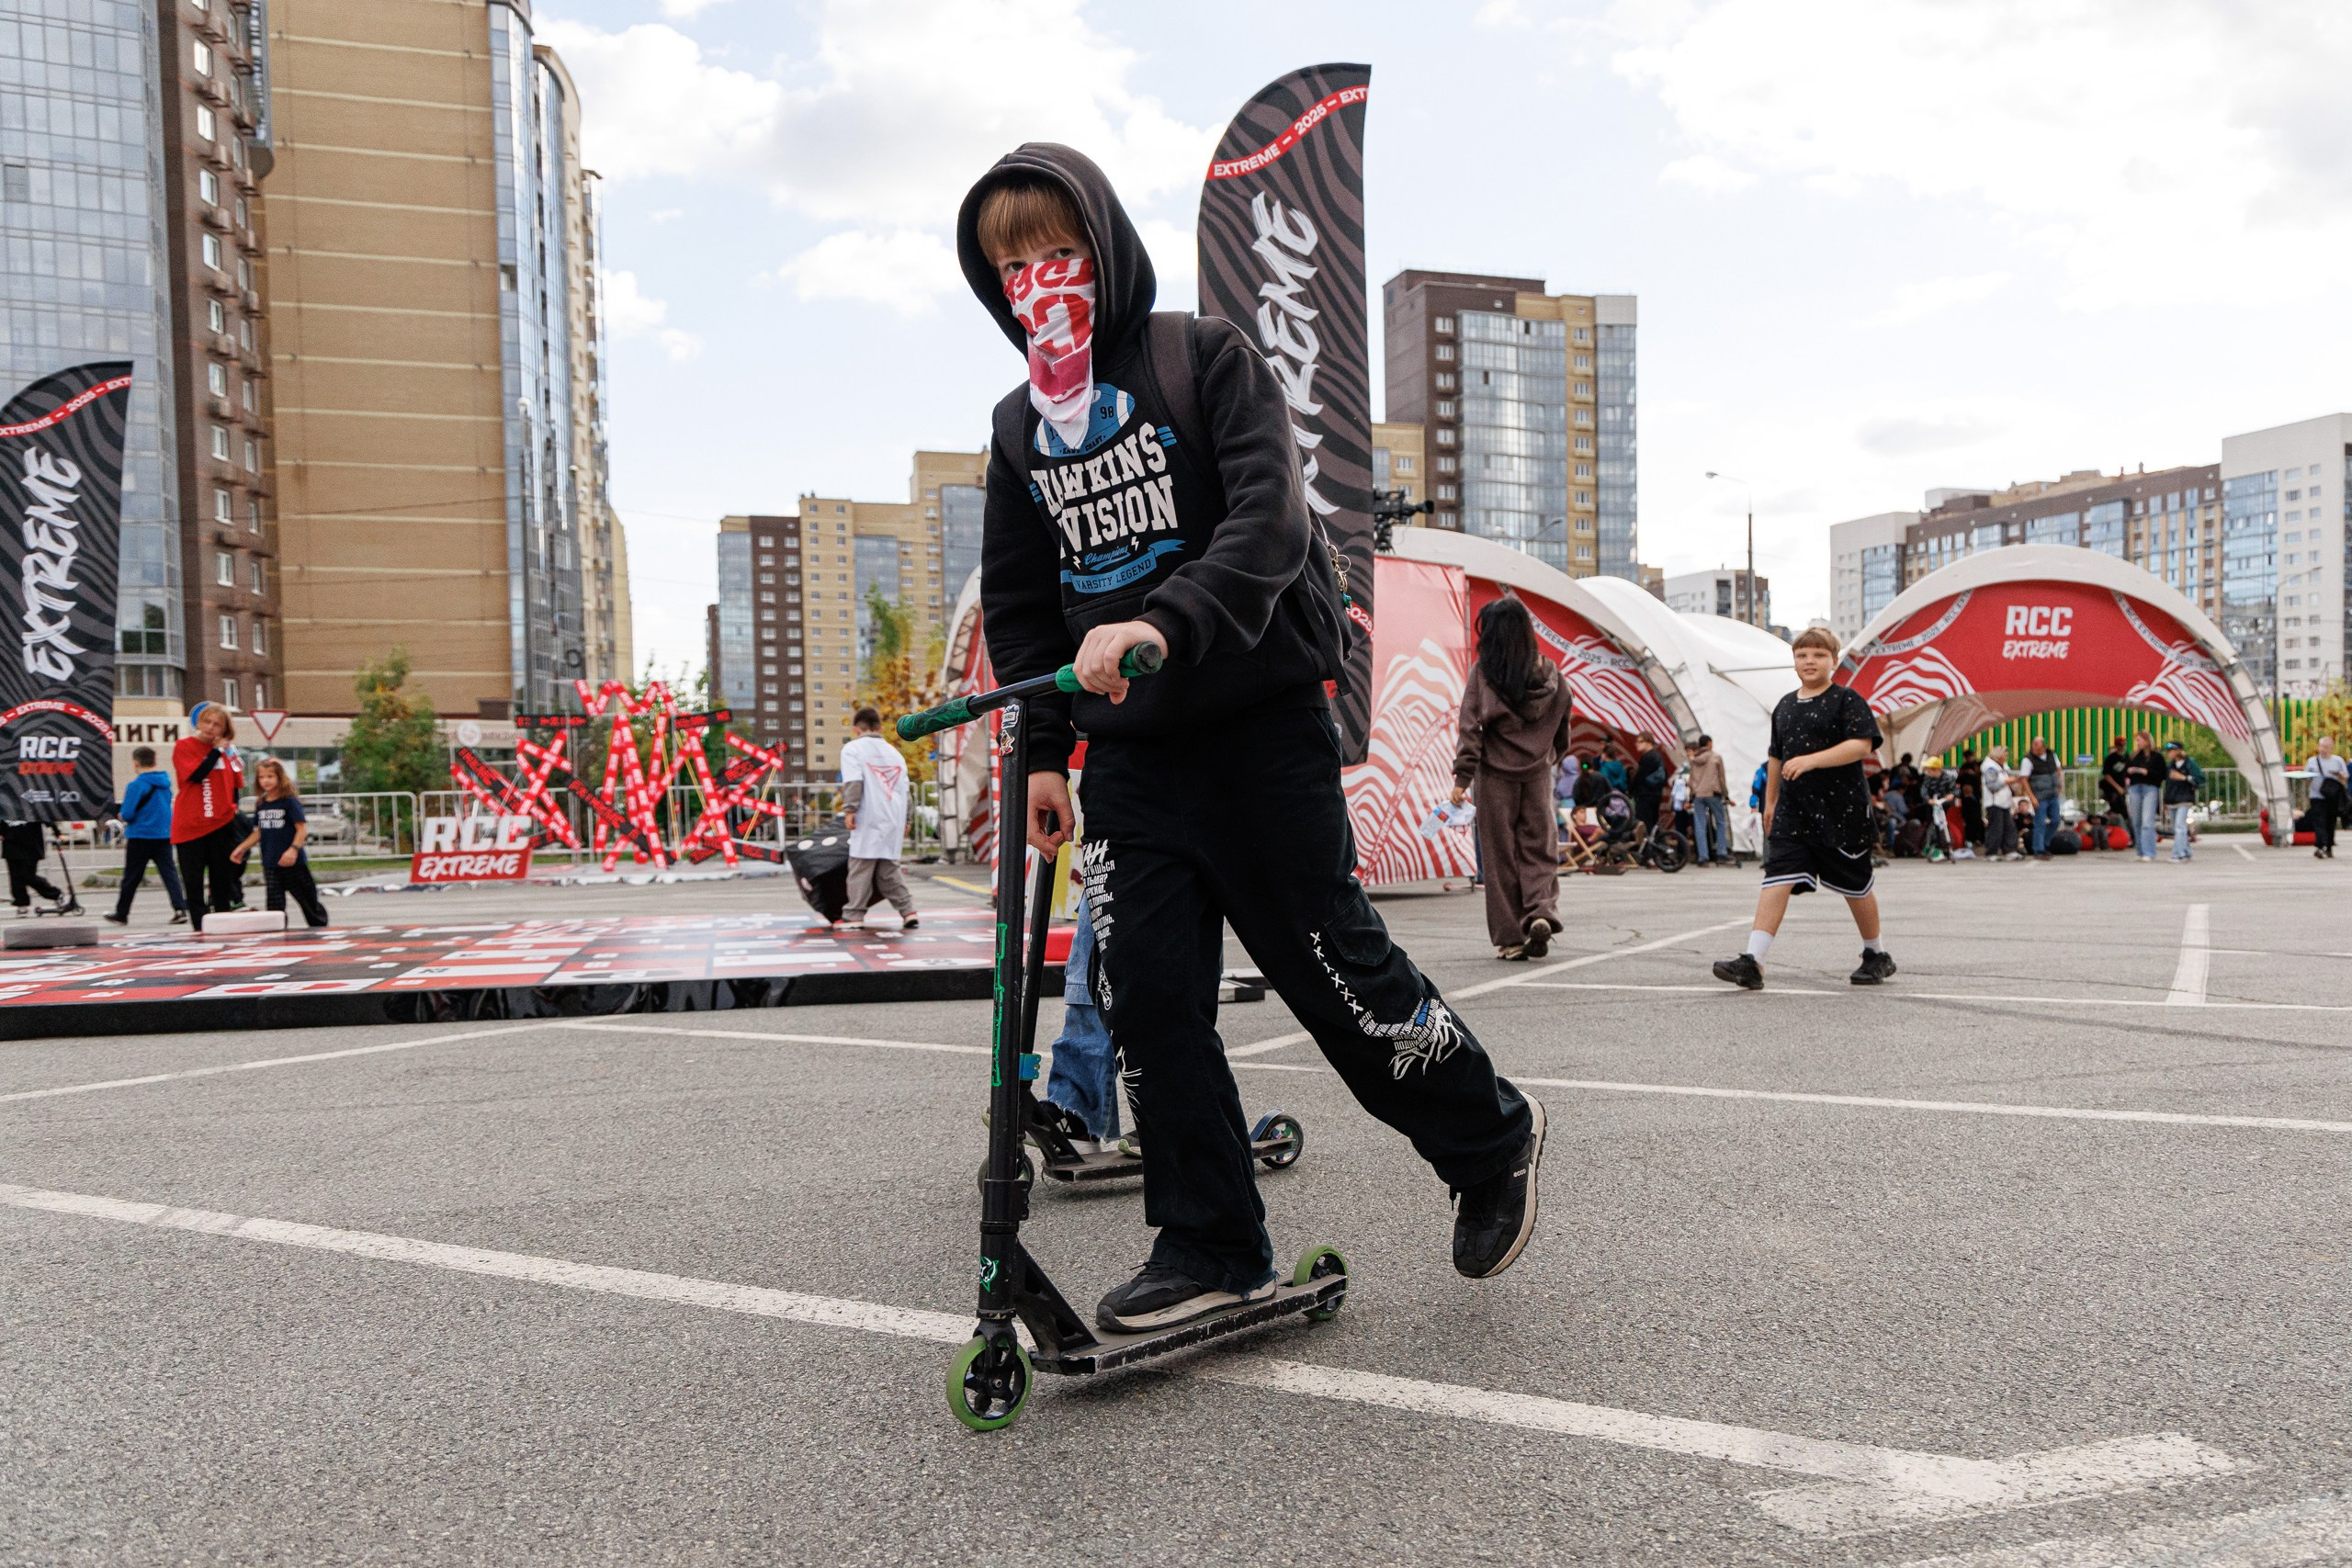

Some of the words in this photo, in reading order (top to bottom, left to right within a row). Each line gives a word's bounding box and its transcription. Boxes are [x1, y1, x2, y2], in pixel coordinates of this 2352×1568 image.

[1213, 143, 1282, 177] EXTREME
[1294, 103, 1328, 136] 2025
[0, 416, 54, 435] XTREME
[65, 389, 97, 412] 2025
[1100, 405, 1114, 420] 98
[21, 446, 87, 682] EXTREME
[1084, 545, 1129, 566] Champions
[1076, 576, 1114, 590] VARSITY
[1115, 558, 1152, 583] LEGEND
[1346, 606, 1374, 632] 025
[2005, 605, 2074, 637] RCC
[2002, 639, 2071, 660] EXTREME
[19, 736, 83, 760] RCC
[421, 815, 532, 853] RCC
[418, 853, 522, 881] EXTREME
